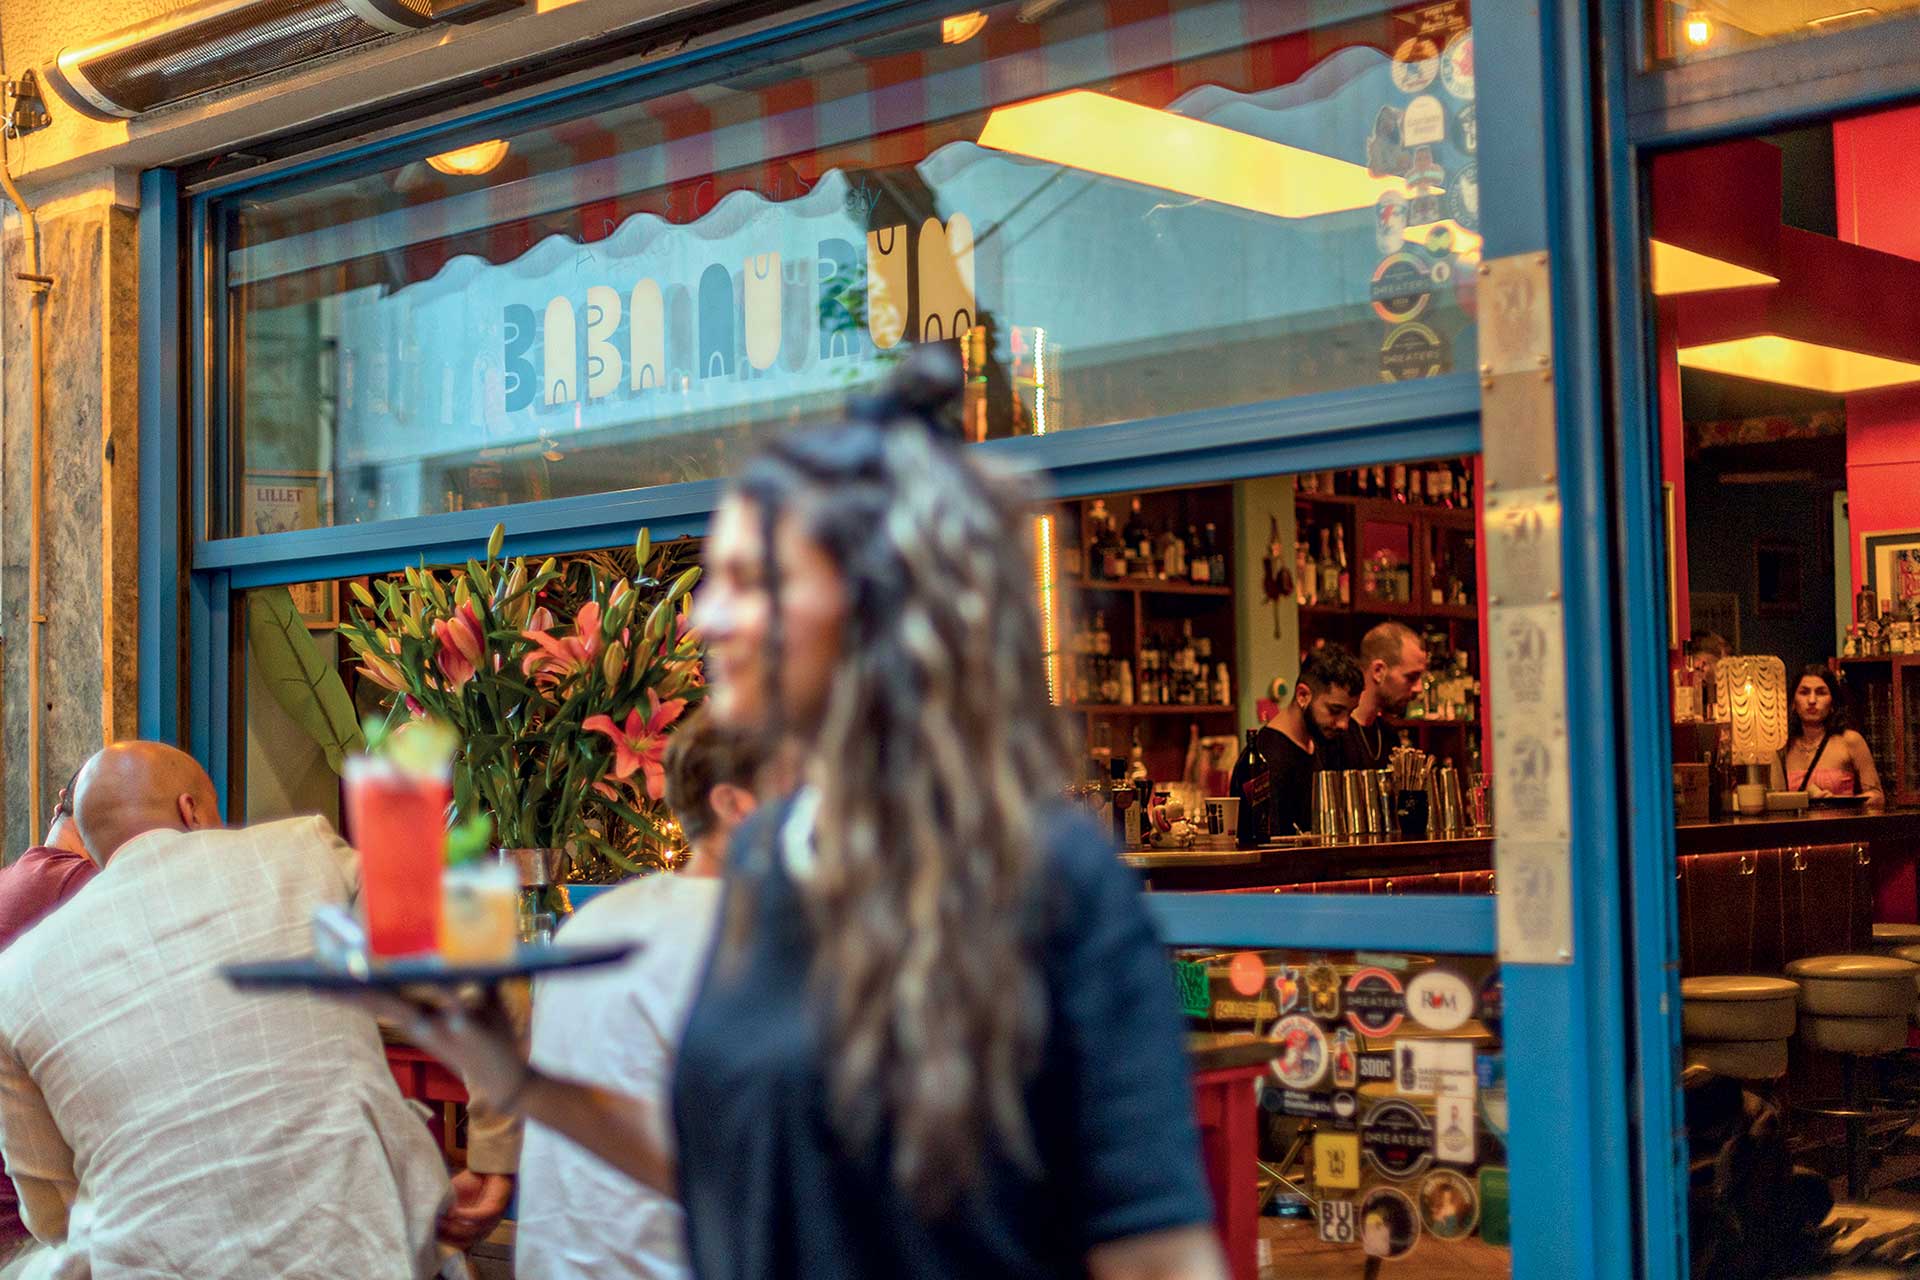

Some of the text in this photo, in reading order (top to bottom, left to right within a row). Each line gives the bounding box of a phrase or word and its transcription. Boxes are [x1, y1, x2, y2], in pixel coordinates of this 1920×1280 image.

[503, 211, 976, 413] BABA AU RUM
[256, 488, 303, 502] LILLET
